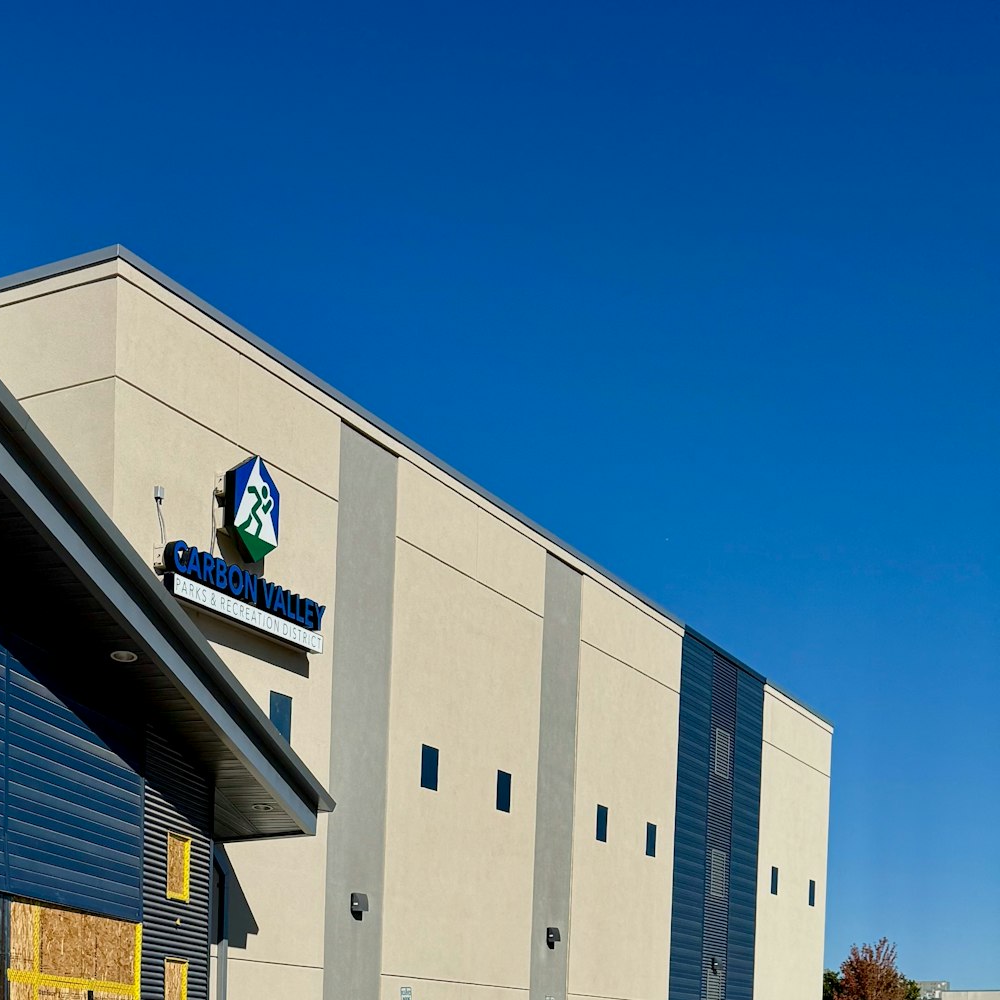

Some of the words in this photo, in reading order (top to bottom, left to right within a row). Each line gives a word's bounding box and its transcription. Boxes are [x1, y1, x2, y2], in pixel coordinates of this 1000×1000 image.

[173, 540, 258, 604] CARBON
[263, 578, 326, 631] VALLEY
[175, 577, 207, 602] PARKS
[210, 592, 216, 605] &
[220, 596, 280, 633] RECREATION
[282, 622, 322, 650] DISTRICT
